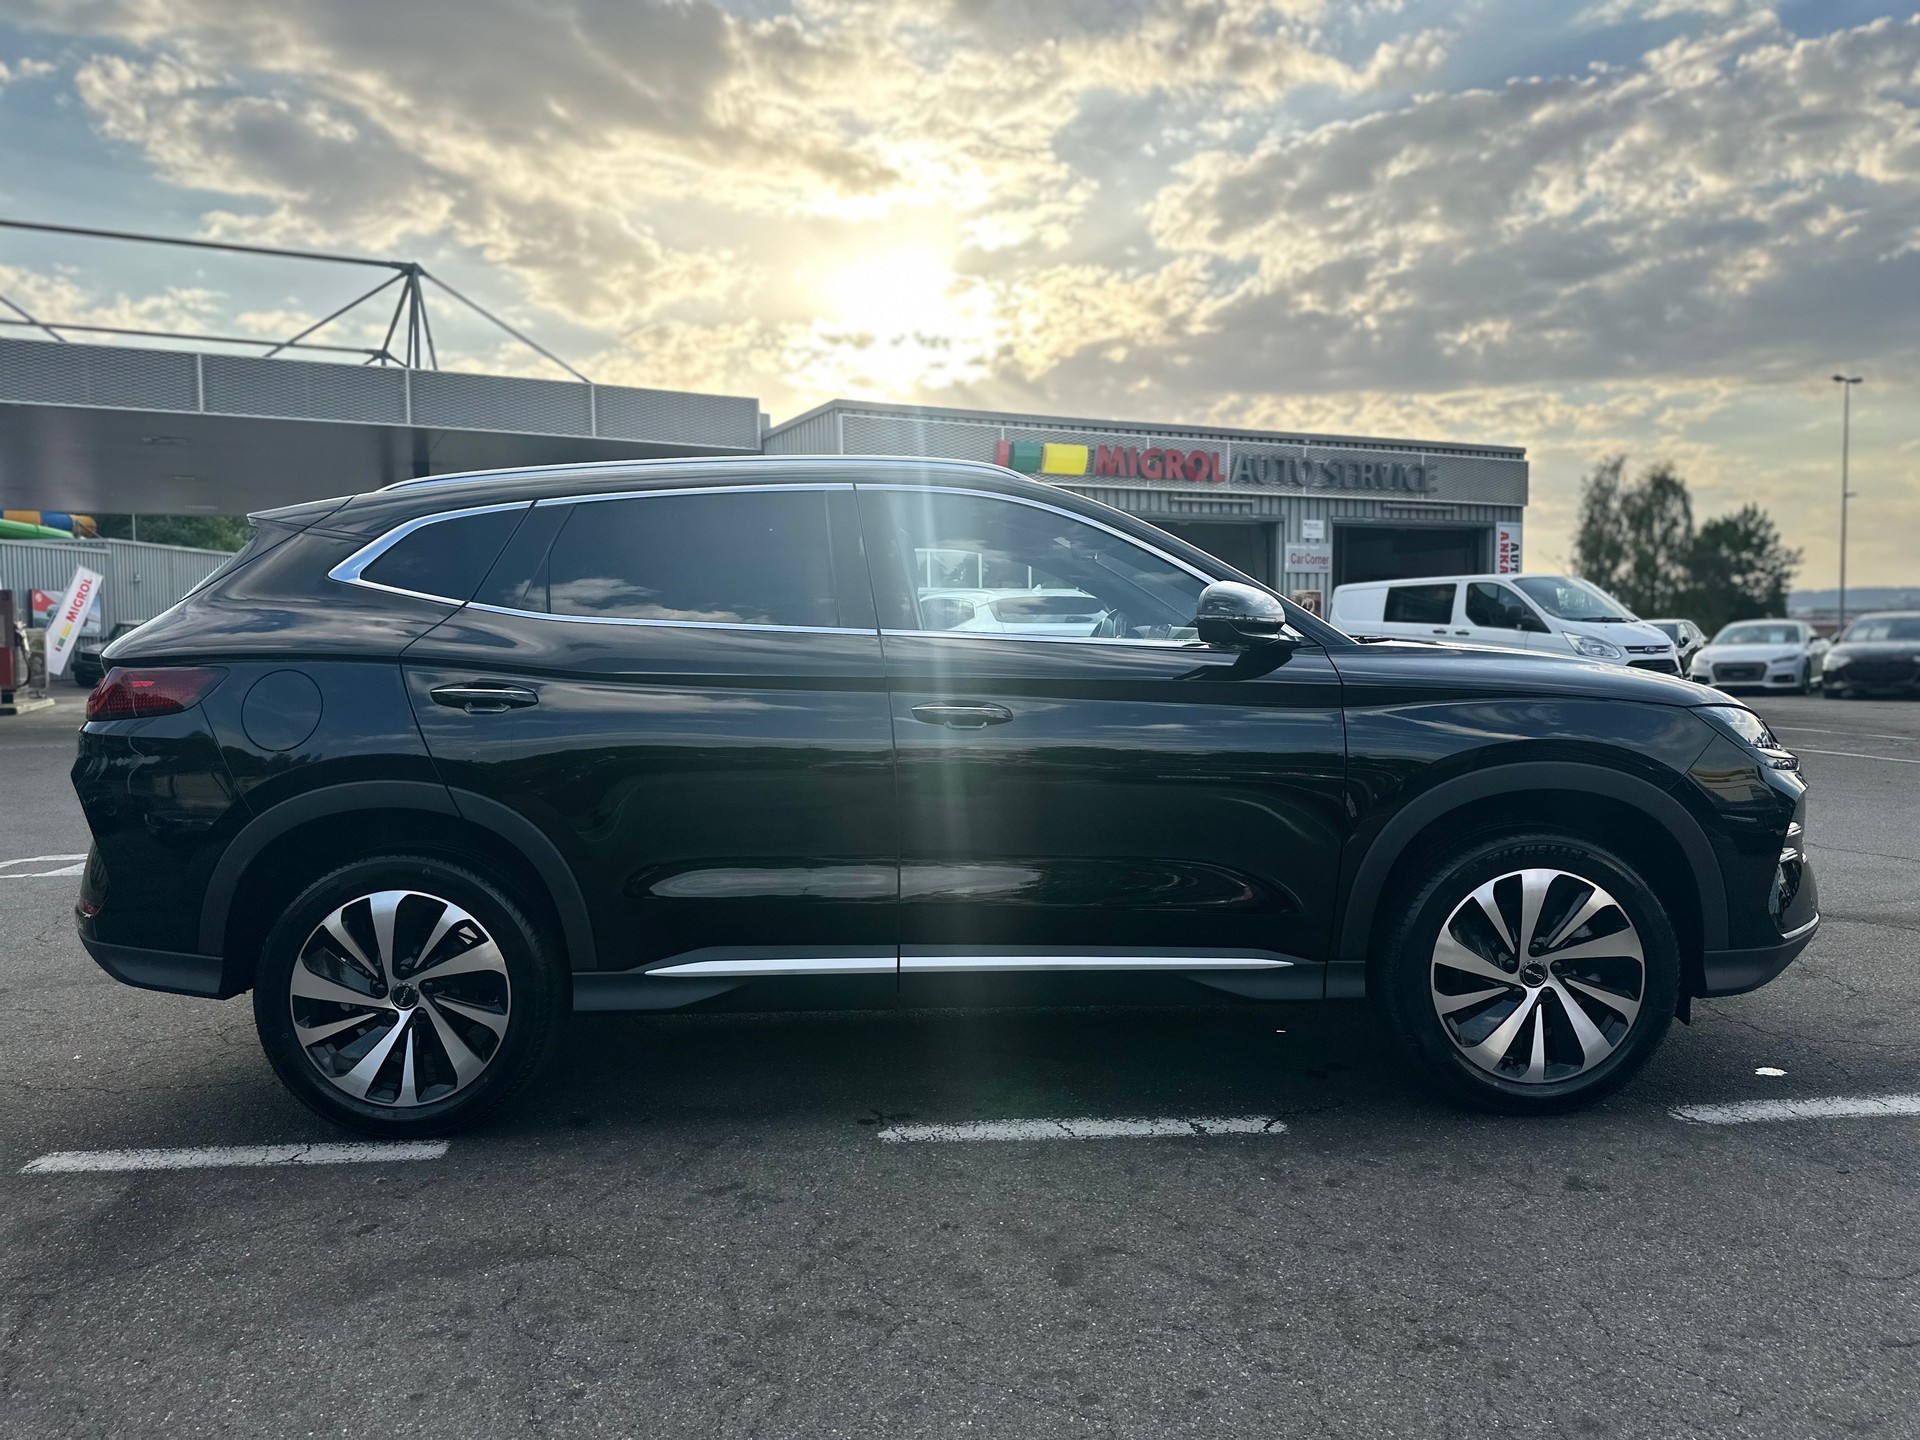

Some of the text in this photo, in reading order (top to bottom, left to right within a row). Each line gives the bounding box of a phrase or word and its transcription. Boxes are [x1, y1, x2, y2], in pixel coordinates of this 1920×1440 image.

[1095, 444, 1438, 493] MIGROL AUTO SERVICE
[65, 578, 93, 623] MIGROL
